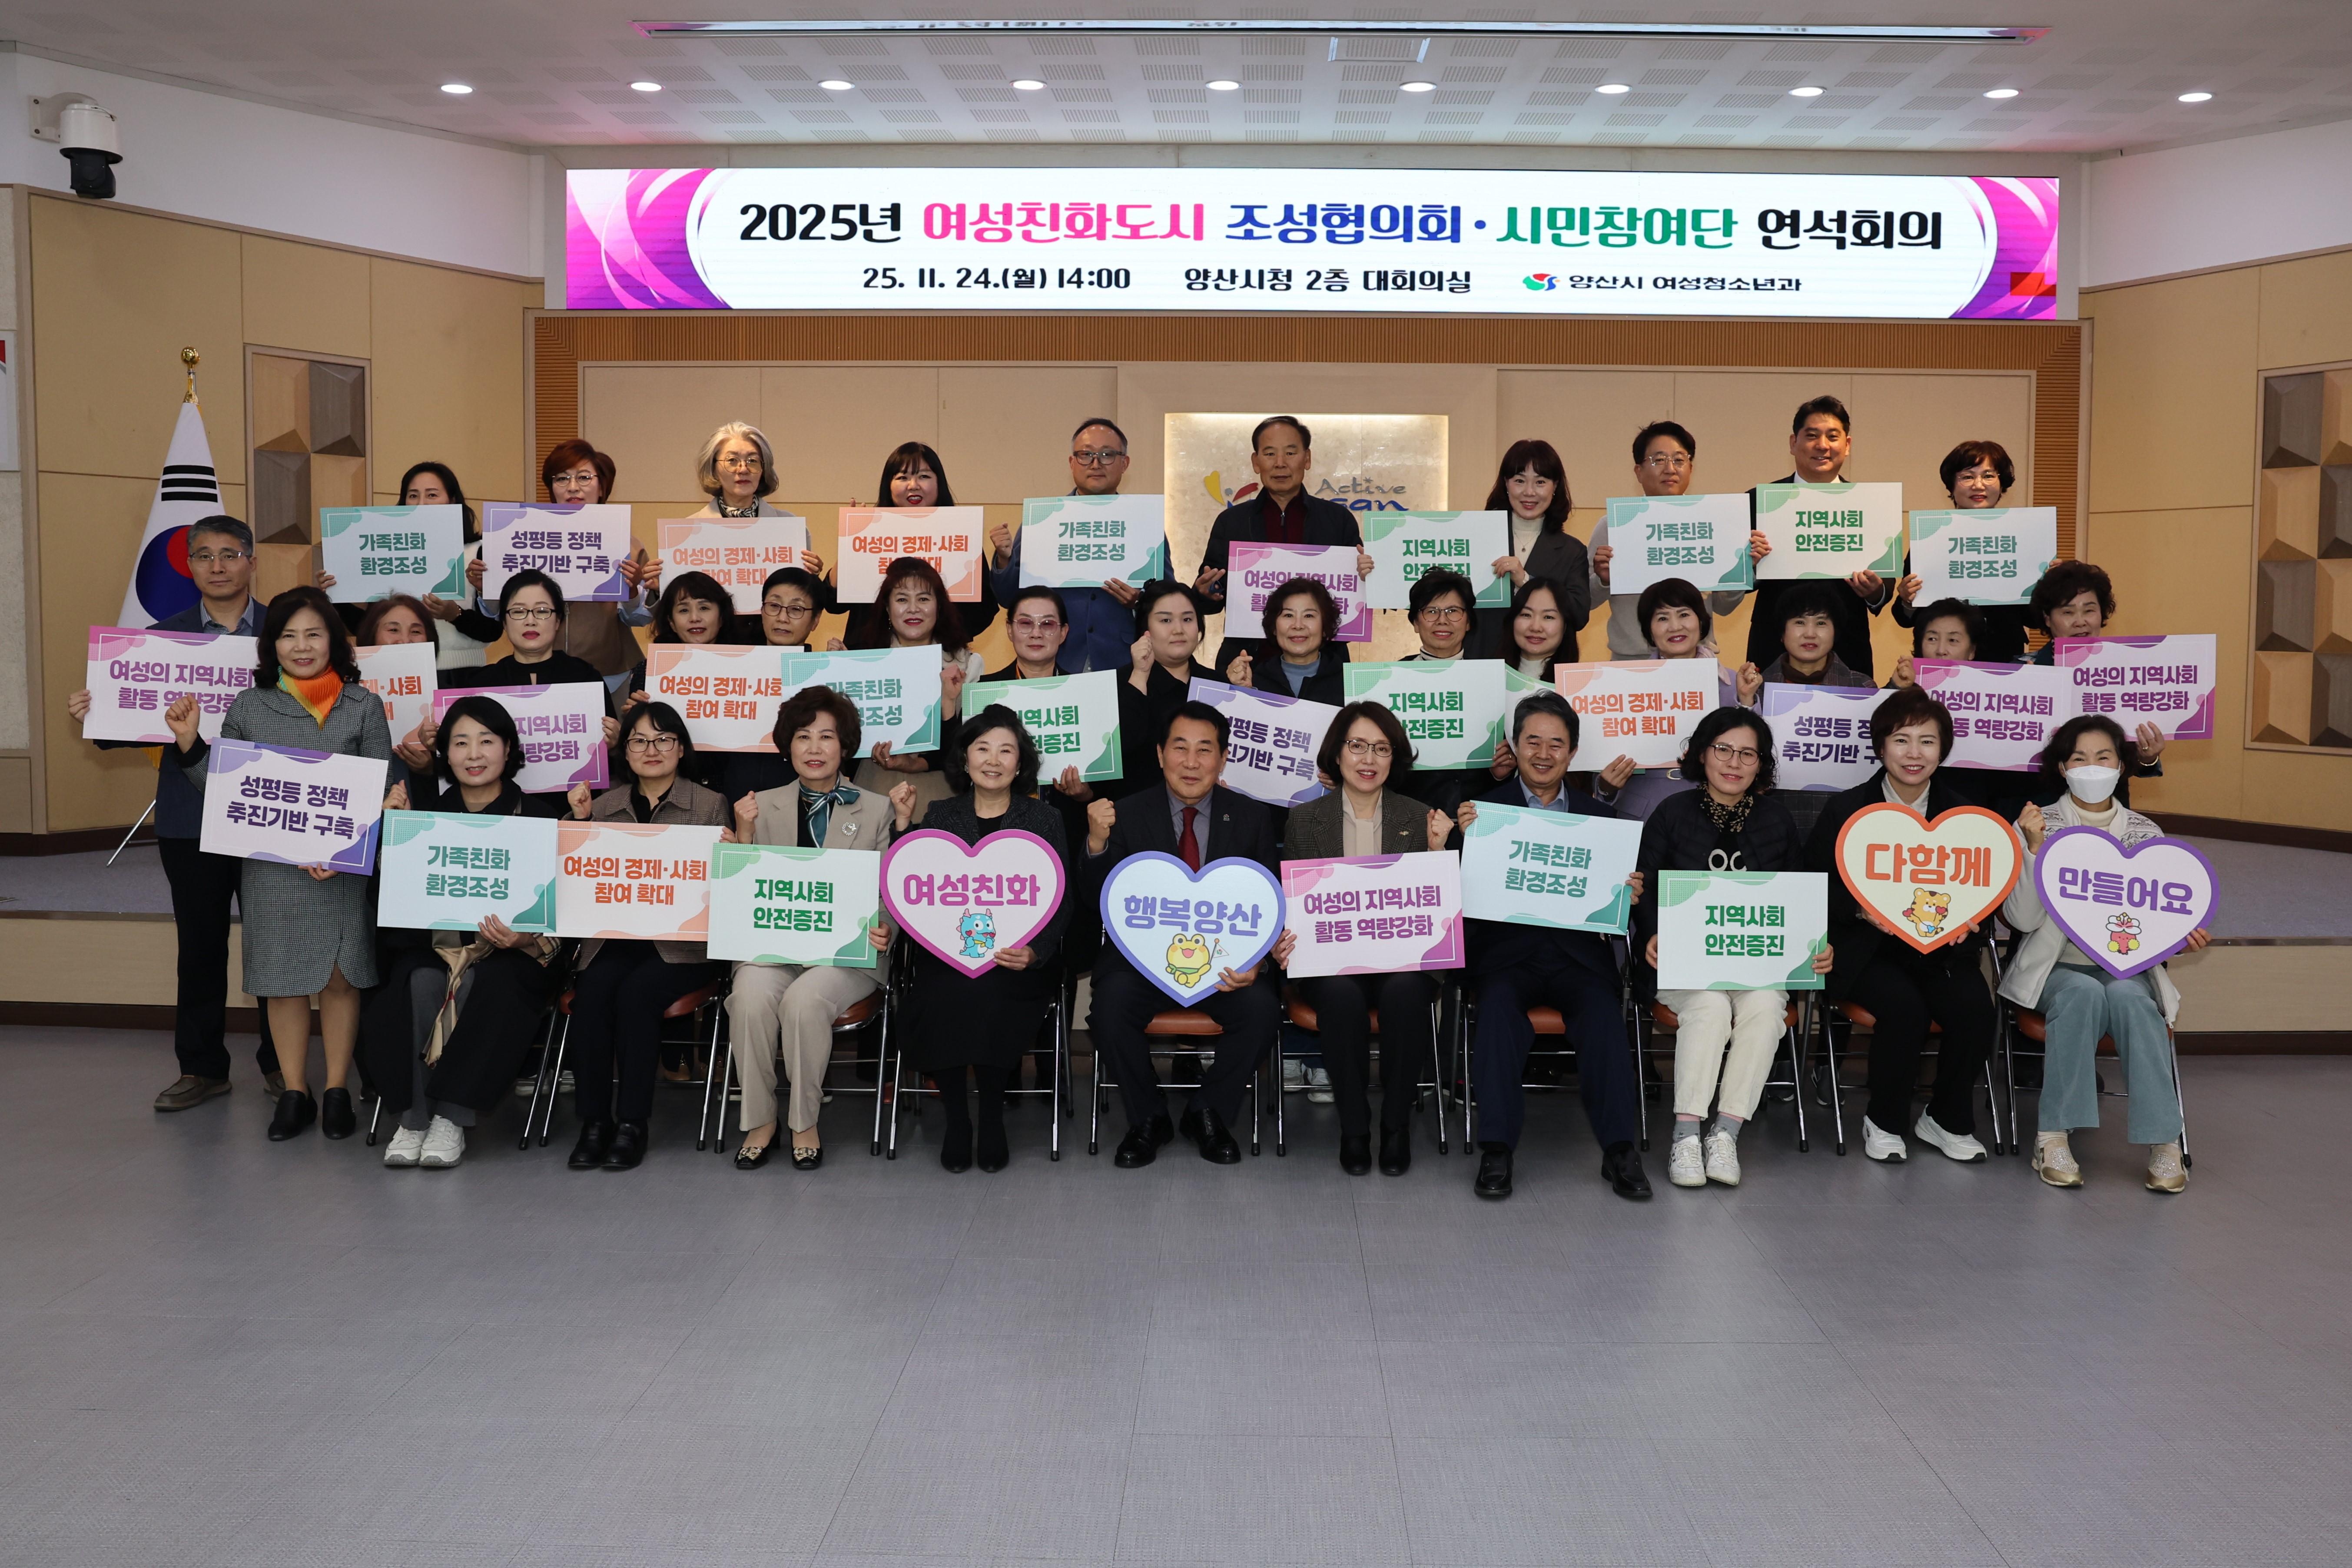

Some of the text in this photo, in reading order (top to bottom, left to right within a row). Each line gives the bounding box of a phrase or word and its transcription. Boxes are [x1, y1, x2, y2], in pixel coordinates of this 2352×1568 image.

[740, 203, 901, 243] 2025년
[924, 202, 1204, 243] 여성친화도시
[1758, 209, 1941, 250] 연석회의
[864, 268, 904, 288] 25.
[957, 268, 1046, 288] 24.(월)
[1058, 268, 1130, 288] 14:00
[1185, 269, 1292, 291] 양산시청
[1307, 269, 1349, 292] 2층
[1363, 270, 1470, 293] 대회의실
[1569, 276, 1642, 289] 양산시
[1653, 277, 1801, 291] 여성청소년과
[1315, 477, 1407, 495] Active
[1059, 520, 1126, 538] 가족친화
[1795, 510, 1862, 528] 지역사회
[359, 533, 426, 551] 가족친화
[511, 531, 601, 550] 성평등 정책
[1646, 522, 1713, 541] 가족친화
[853, 537, 898, 554] 여성의
[1058, 544, 1125, 561] 환경조성
[1403, 539, 1470, 557] 지역사회
[1796, 534, 1863, 552] 안전증진
[1949, 536, 2017, 554] 가족친화
[361, 556, 427, 575] 환경조성
[502, 554, 609, 573] 추진기반 구축
[673, 548, 720, 566] 여성의
[1647, 546, 1714, 565] 환경조성
[736, 568, 766, 586] 확대
[1949, 560, 2017, 579] 환경조성
[110, 660, 253, 688] 여성의 지역사회
[2073, 665, 2197, 686] 여성의 지역사회
[660, 676, 708, 695] 여성의
[118, 687, 158, 710] 활동
[686, 699, 756, 719] 참여 확대
[1388, 691, 1463, 713] 지역사회
[1572, 694, 1623, 714] 여성의
[1931, 690, 2053, 716] 여성의 지역사회
[2082, 691, 2189, 712] 활동 역량강화
[514, 714, 587, 736] 지역사회
[1603, 716, 1675, 737] 참여 확대
[1795, 716, 1851, 738] 성평등
[1974, 719, 2043, 741] 역량강화
[1030, 732, 1081, 754] 전증진
[1273, 727, 1311, 753] 정책
[520, 740, 579, 763] 량강화
[1226, 742, 1314, 781] 진기반 구축
[1783, 741, 1859, 763] 추진기반
[240, 775, 348, 810] 성평등 정책
[227, 801, 354, 839] 추진기반 구축
[428, 846, 510, 870] 가족친화
[1509, 840, 1592, 870] 가족친화
[1866, 843, 1991, 887] 다함께
[564, 856, 619, 878] 여성의
[426, 873, 508, 900] 환경조성
[595, 882, 673, 905] 참여 확대
[754, 879, 833, 903] 지역사회
[904, 874, 1040, 906] 여성친화
[1505, 868, 1588, 898] 환경조성
[2059, 867, 2193, 915] 만들어요
[1304, 885, 1440, 914] 여성의 지역사회
[754, 908, 832, 932] 안전증진
[1124, 895, 1262, 937] 행복양산
[1705, 905, 1784, 927] 지역사회
[1315, 915, 1433, 943] 활동 역량강화
[1705, 934, 1784, 956] 안전증진
